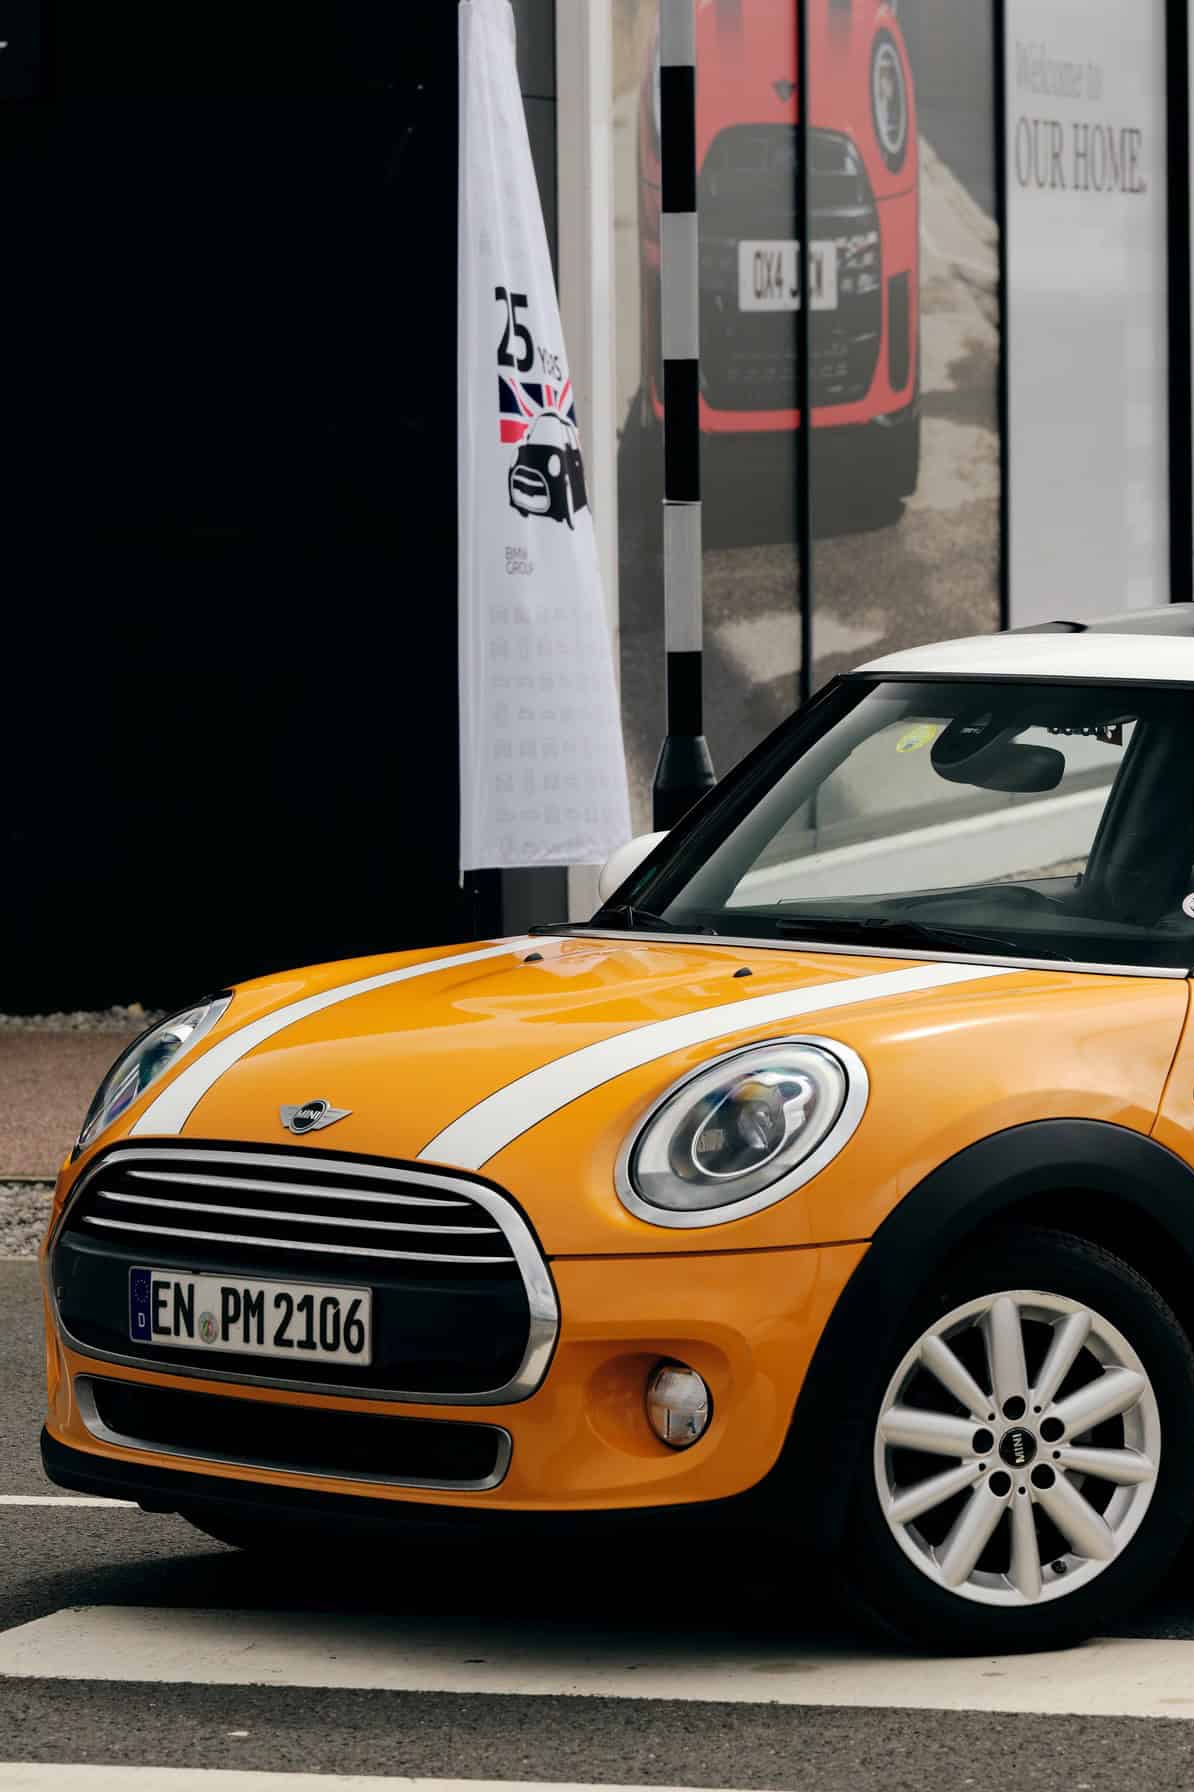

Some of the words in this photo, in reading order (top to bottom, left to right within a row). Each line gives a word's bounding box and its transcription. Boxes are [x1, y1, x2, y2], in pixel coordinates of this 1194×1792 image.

[1016, 116, 1065, 190] OUR
[495, 286, 534, 372] 25
[298, 1109, 321, 1120] MINI
[138, 1312, 146, 1328] D
[152, 1280, 194, 1338] EN
[220, 1286, 265, 1345] PM
[273, 1292, 365, 1354] 2106
[1012, 1432, 1025, 1464] MINI
